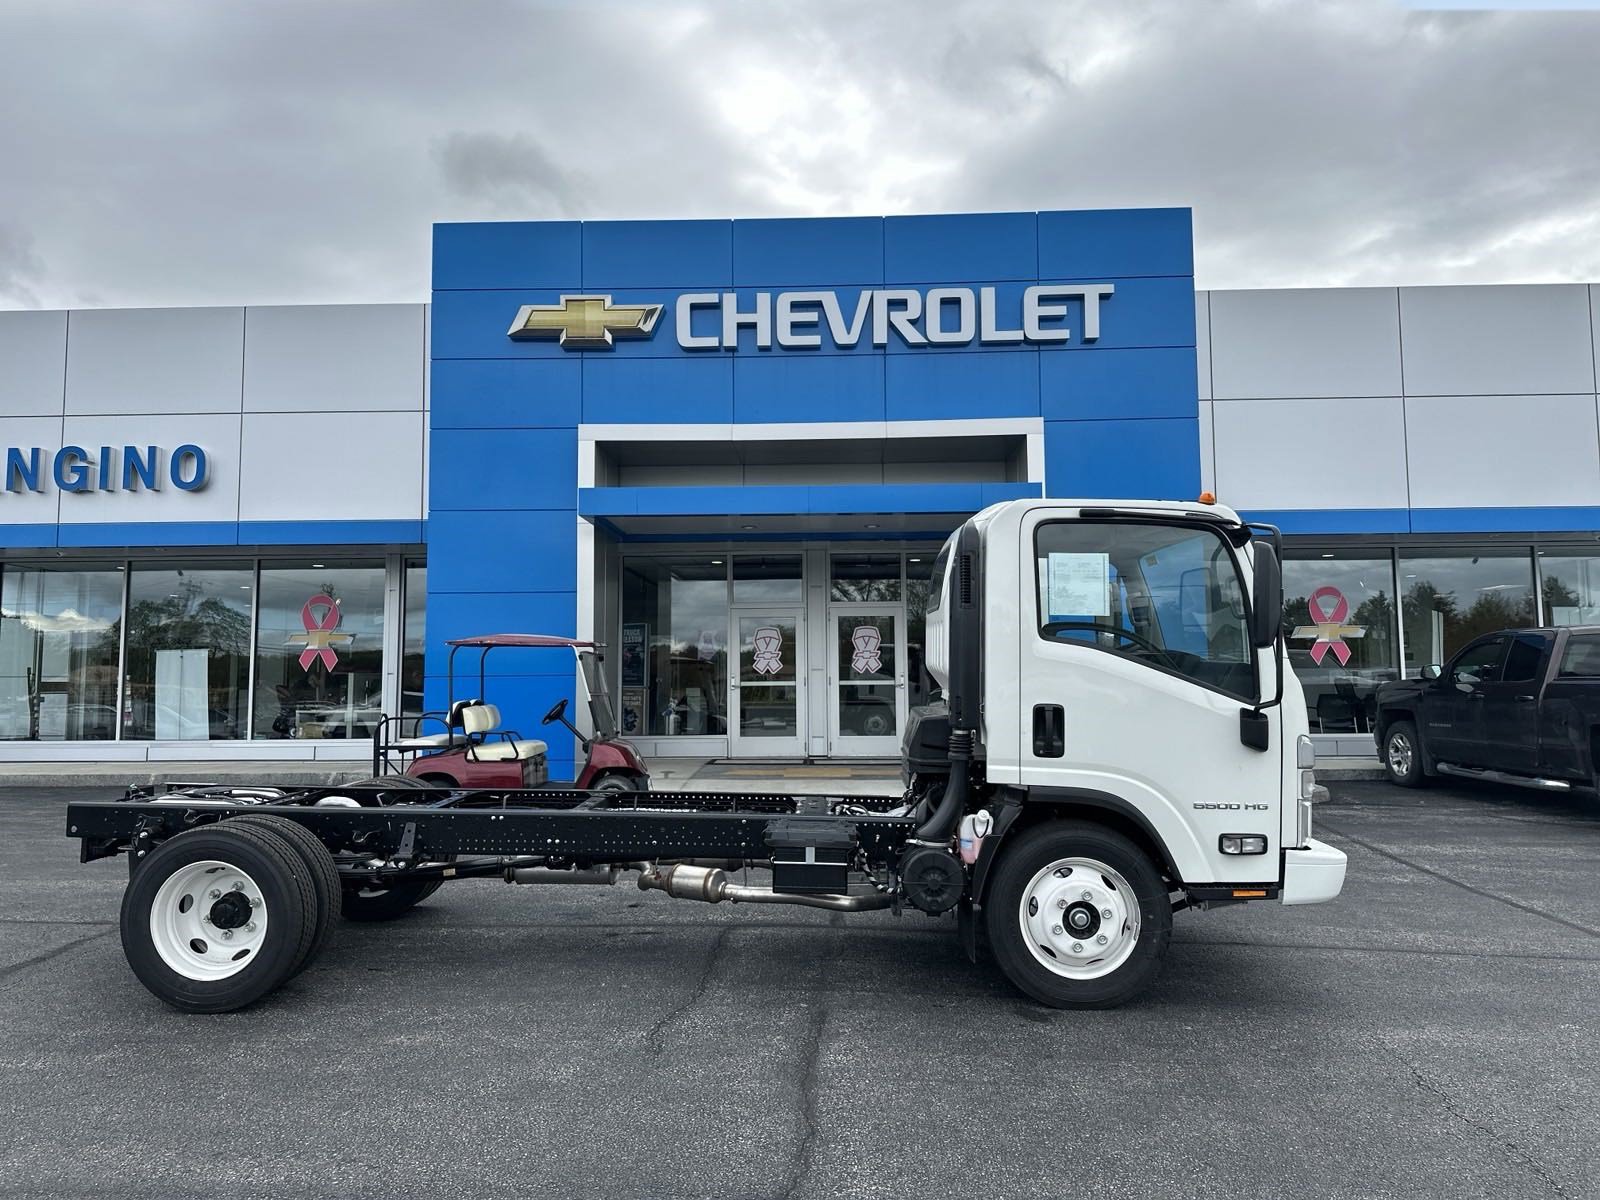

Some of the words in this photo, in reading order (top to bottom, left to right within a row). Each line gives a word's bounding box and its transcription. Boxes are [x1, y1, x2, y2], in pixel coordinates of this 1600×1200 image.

[676, 284, 1115, 349] CHEVROLET
[0, 444, 208, 492] NGINO
[1193, 802, 1241, 810] 5500
[1244, 803, 1269, 811] HG
